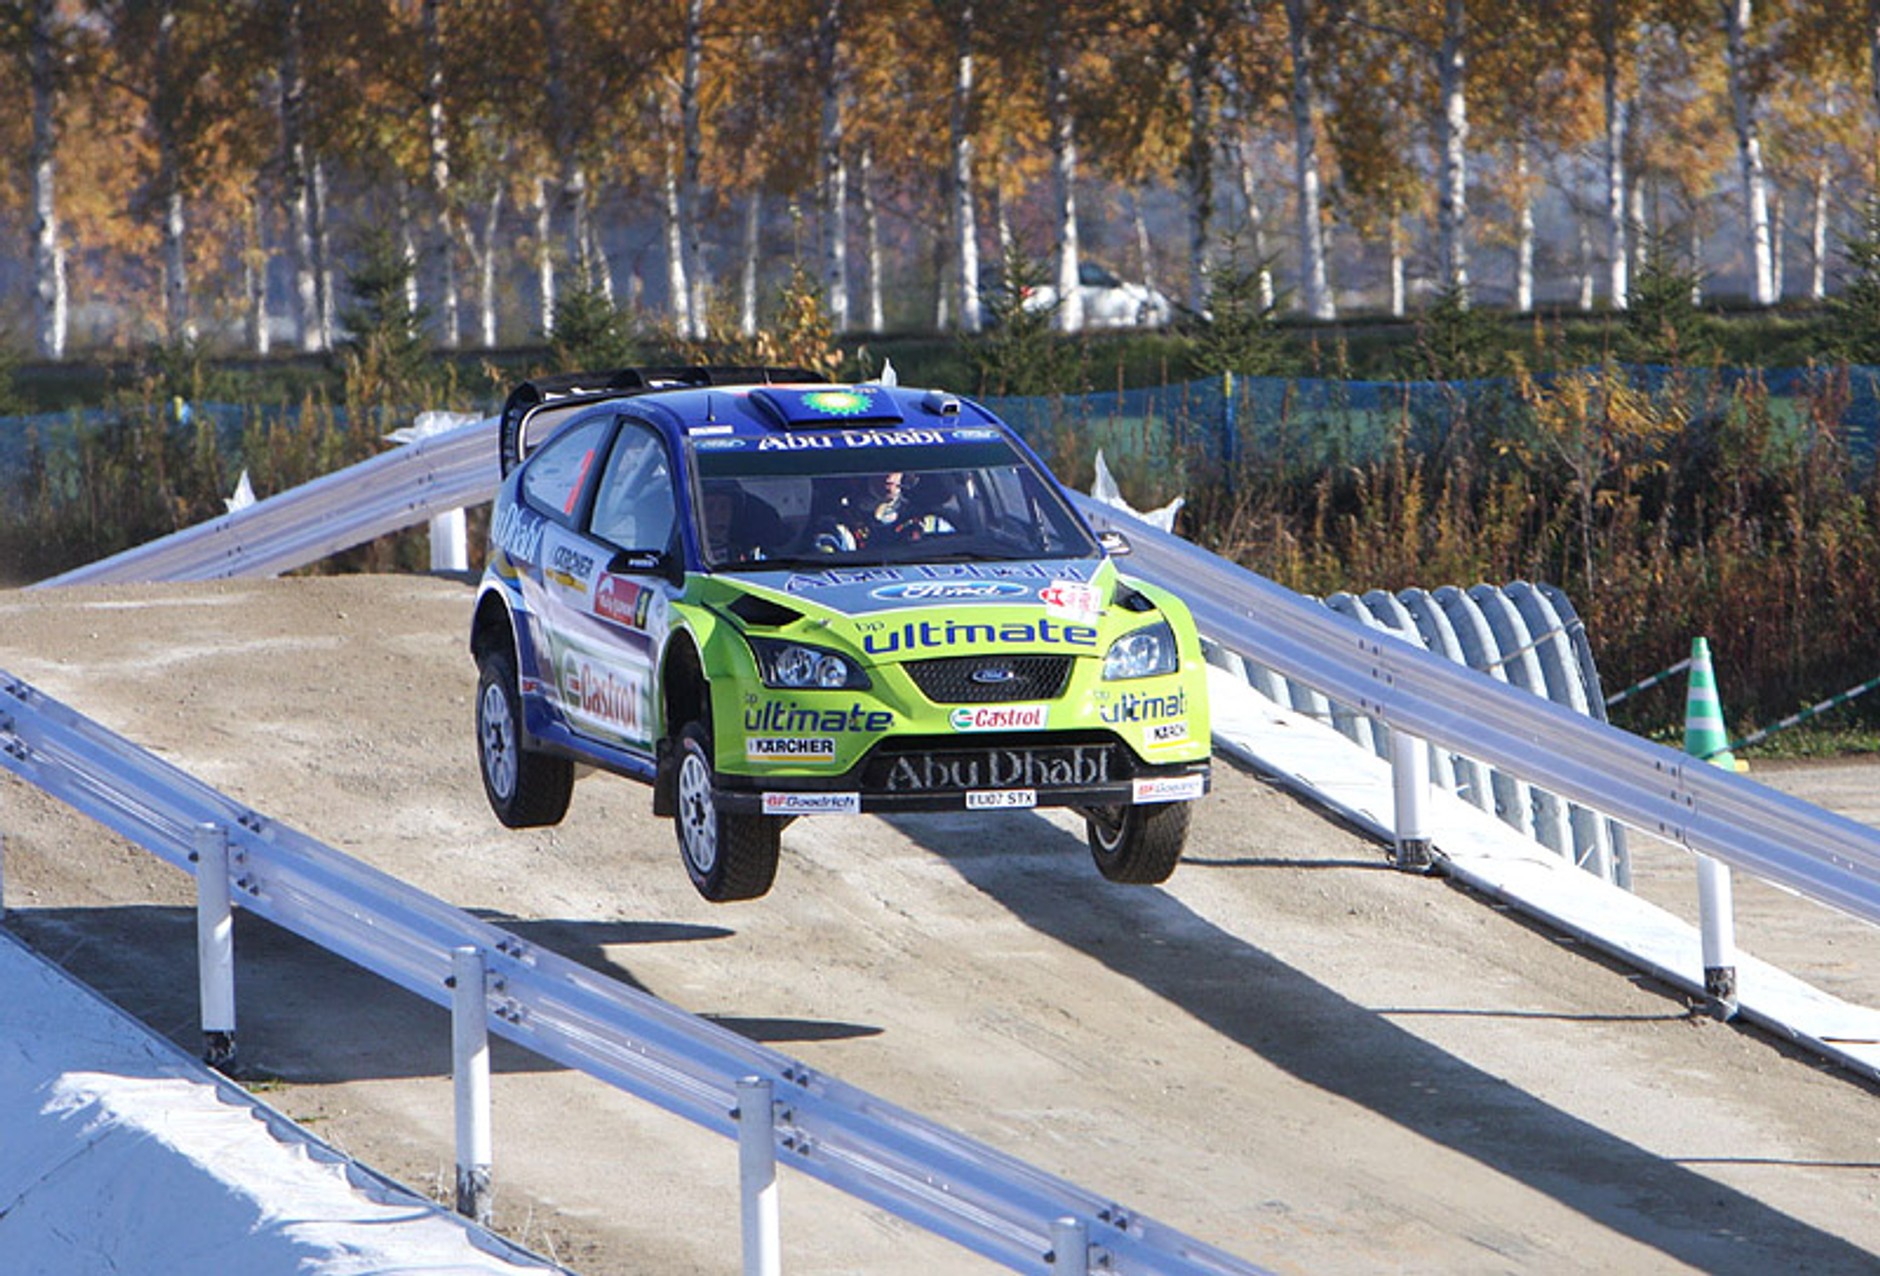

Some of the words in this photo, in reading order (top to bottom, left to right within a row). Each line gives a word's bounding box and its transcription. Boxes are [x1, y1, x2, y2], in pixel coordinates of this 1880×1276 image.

[758, 432, 833, 450] Abu
[843, 428, 945, 447] Dhabi
[900, 583, 1001, 600] Ford
[855, 621, 885, 632] bp
[864, 619, 1097, 654] ultimate
[583, 663, 637, 728] Castrol
[745, 701, 894, 732] ultimate
[975, 708, 1041, 728] Castrol
[887, 752, 979, 791] Abu
[989, 747, 1109, 787] Dhabi
[1007, 791, 1033, 805] STX
